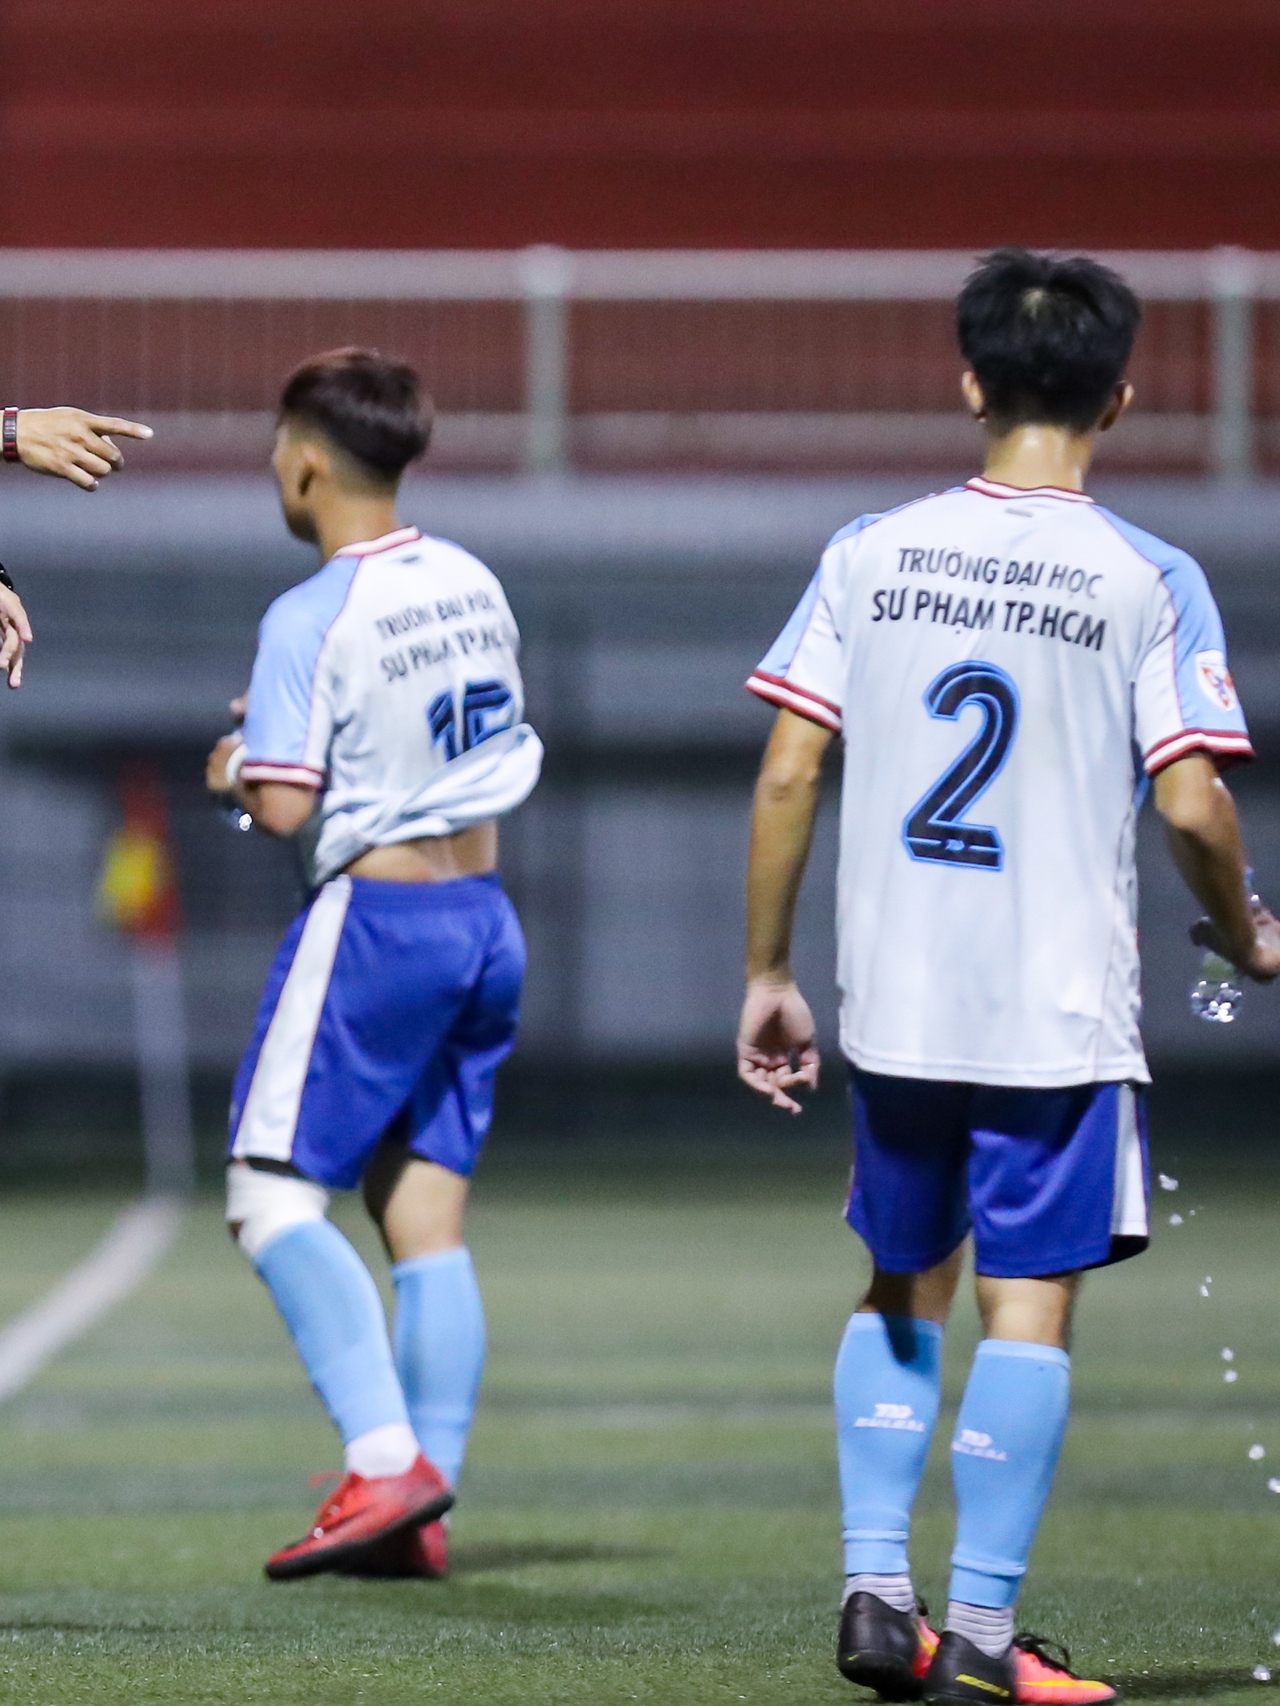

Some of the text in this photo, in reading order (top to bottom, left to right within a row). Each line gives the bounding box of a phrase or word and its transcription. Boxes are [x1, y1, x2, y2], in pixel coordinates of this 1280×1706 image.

[897, 545, 1104, 600] TRƯỜNG ĐẠI HỌC
[871, 585, 1108, 651] SƯ PHẠM TP.HCM
[901, 661, 1020, 872] 2
